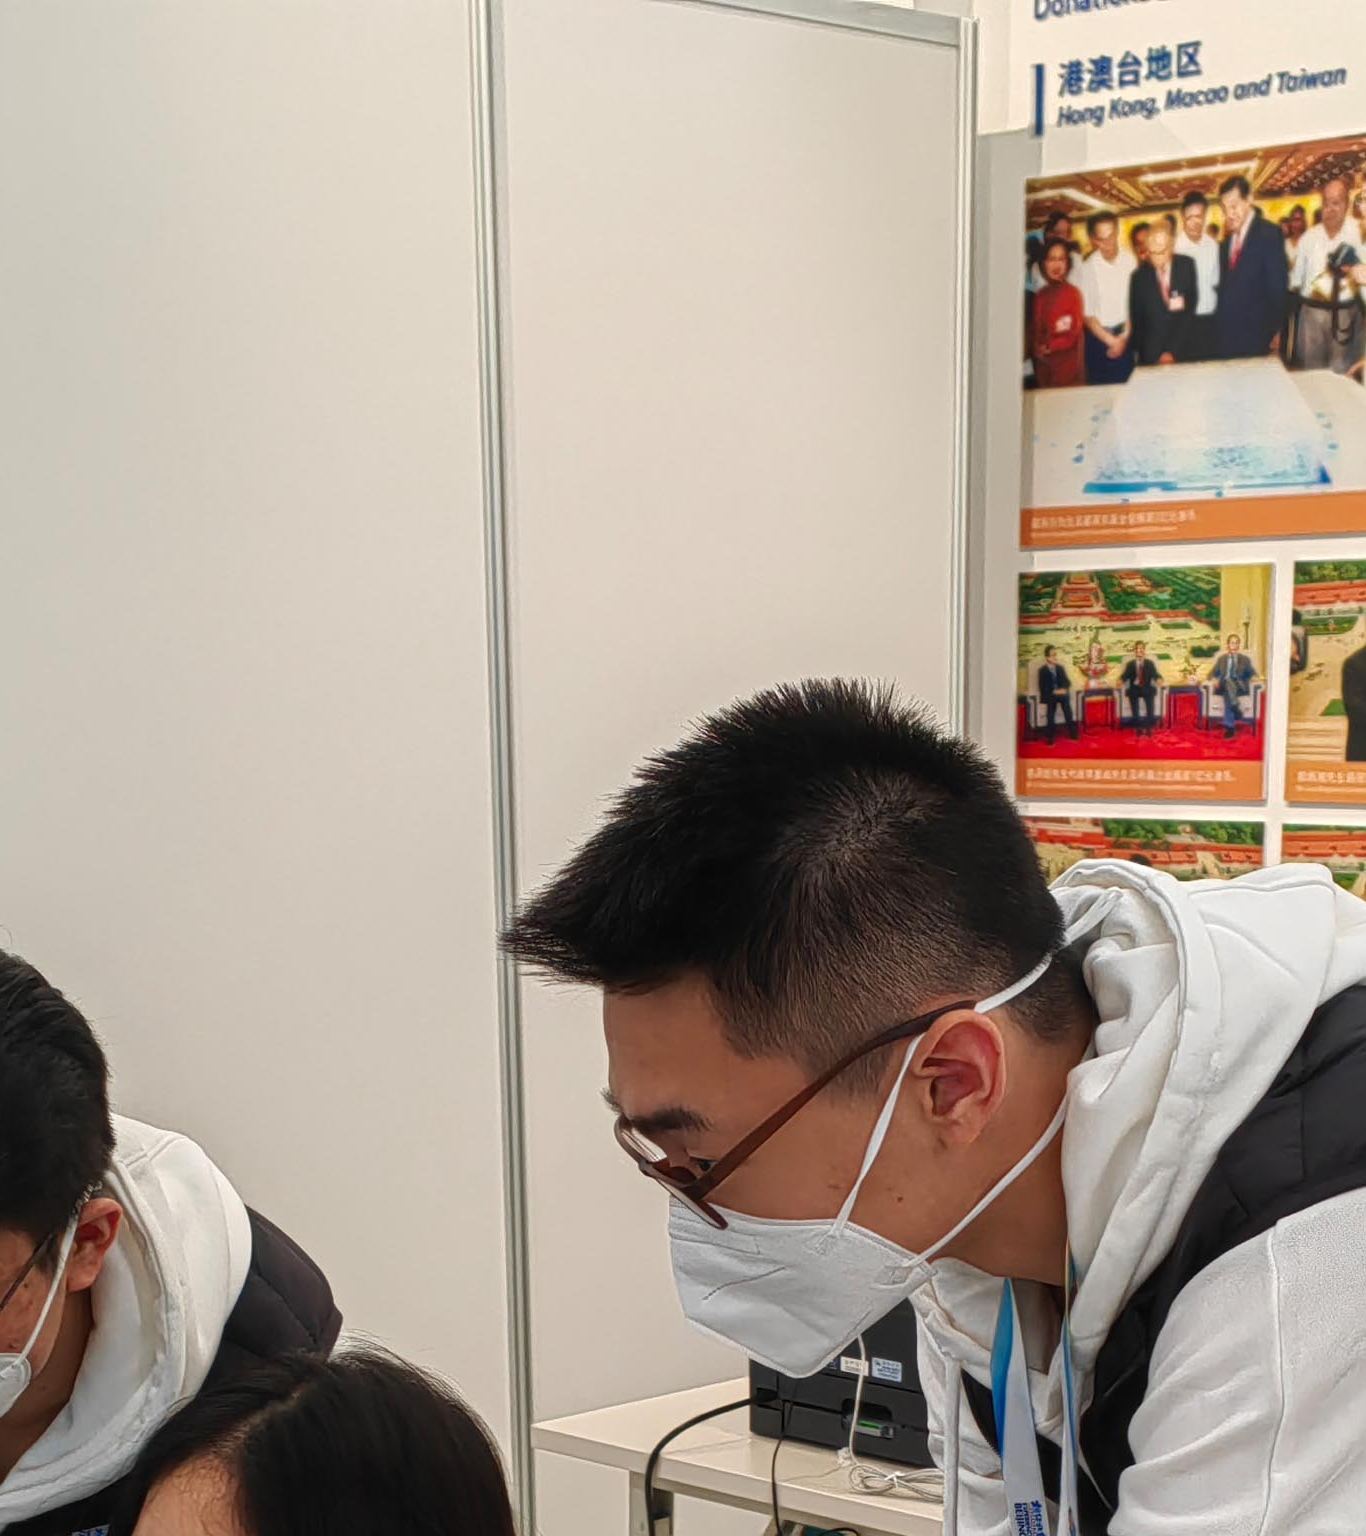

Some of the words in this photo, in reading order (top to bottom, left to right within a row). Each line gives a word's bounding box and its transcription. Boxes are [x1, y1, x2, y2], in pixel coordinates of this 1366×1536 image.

[1057, 104, 1105, 127] Hong
[1109, 97, 1160, 122] Kong,
[1165, 86, 1229, 110] Macao
[1235, 74, 1270, 99] and
[1276, 66, 1347, 95] Taiwan
[1059, 41, 1202, 98] 港澳台地区
